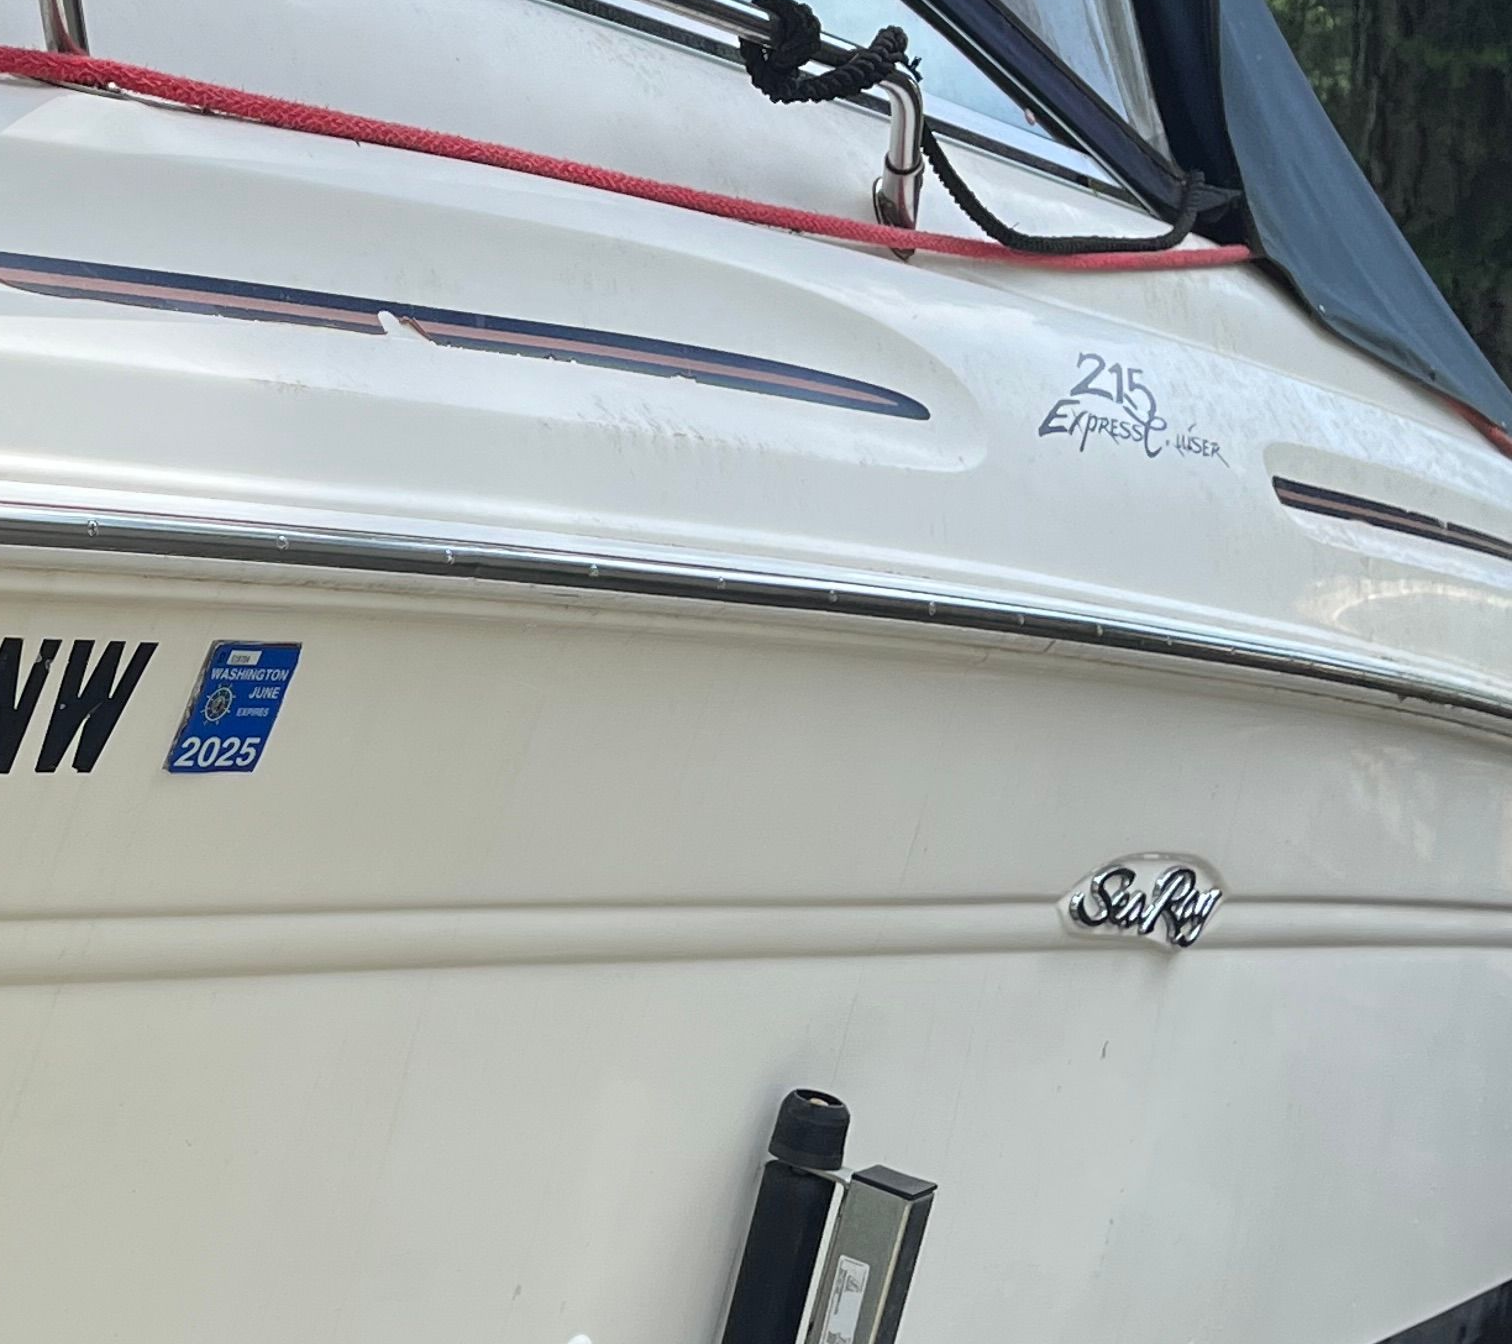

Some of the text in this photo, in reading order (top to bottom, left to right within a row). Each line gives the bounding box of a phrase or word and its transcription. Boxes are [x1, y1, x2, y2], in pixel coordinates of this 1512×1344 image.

[1069, 352, 1157, 416] 215
[210, 667, 289, 682] WASHINGTON
[248, 686, 281, 699] JUNE
[235, 707, 270, 717] EXPIRES
[173, 735, 261, 768] 2025
